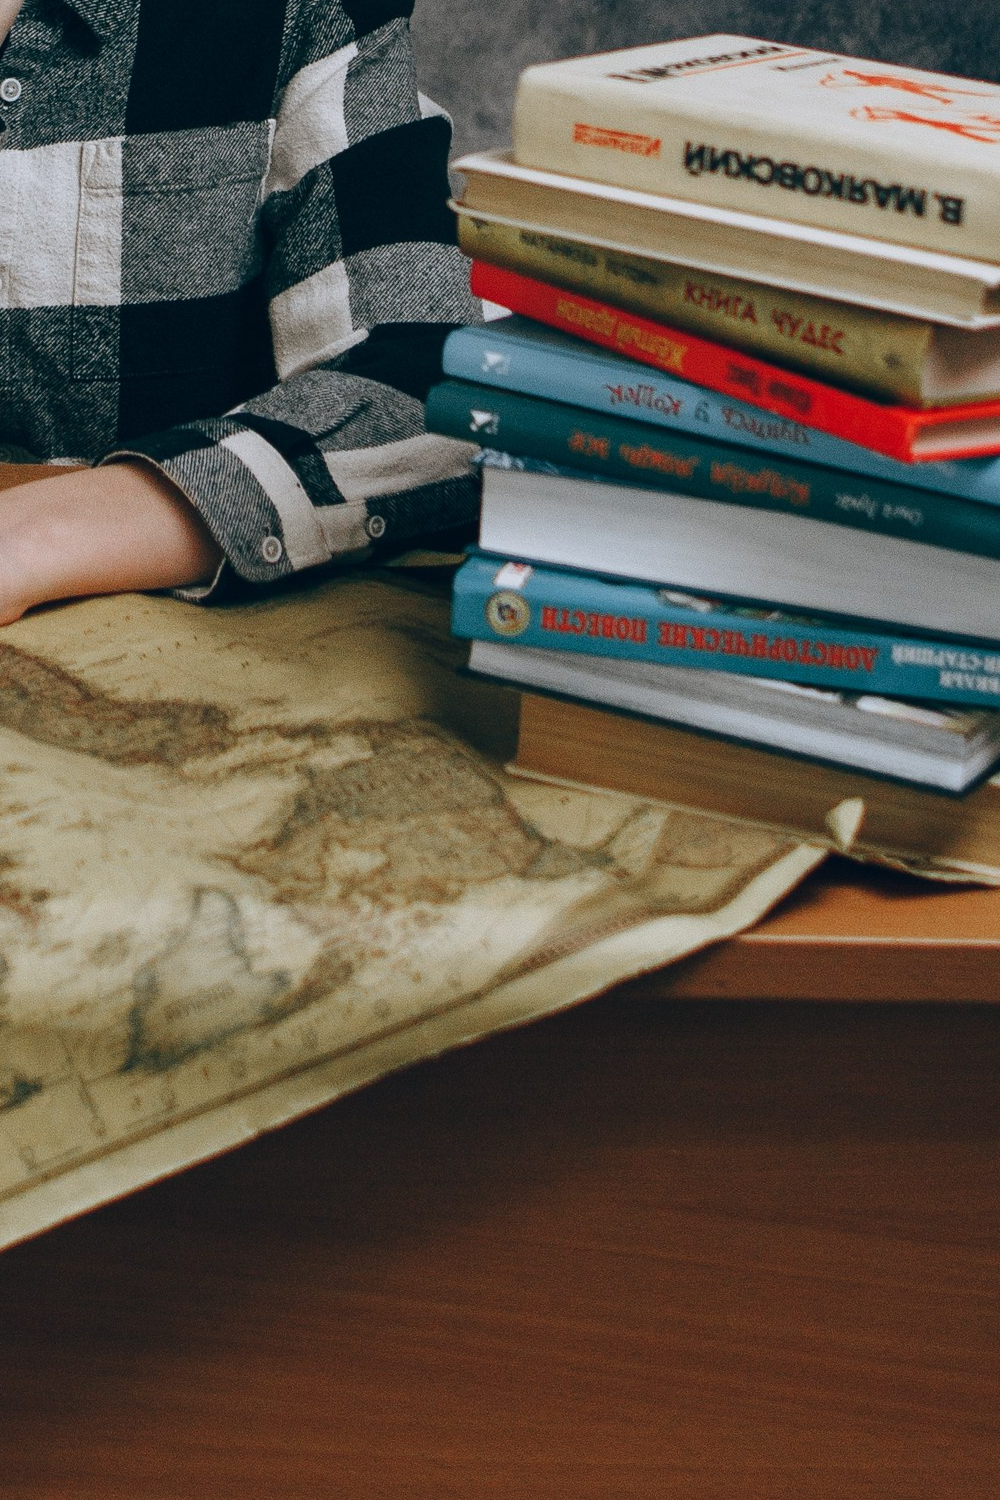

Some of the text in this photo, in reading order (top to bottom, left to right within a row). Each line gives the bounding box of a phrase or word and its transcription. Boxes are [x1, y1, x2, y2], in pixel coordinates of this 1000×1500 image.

[684, 140, 965, 226] В. МАЯКОВСКИЙ
[684, 281, 845, 355] КНИГА ЧУДЕС
[541, 606, 878, 673] ДОИСТОРИЧЕСКИЕ ПОВЕСТИ
